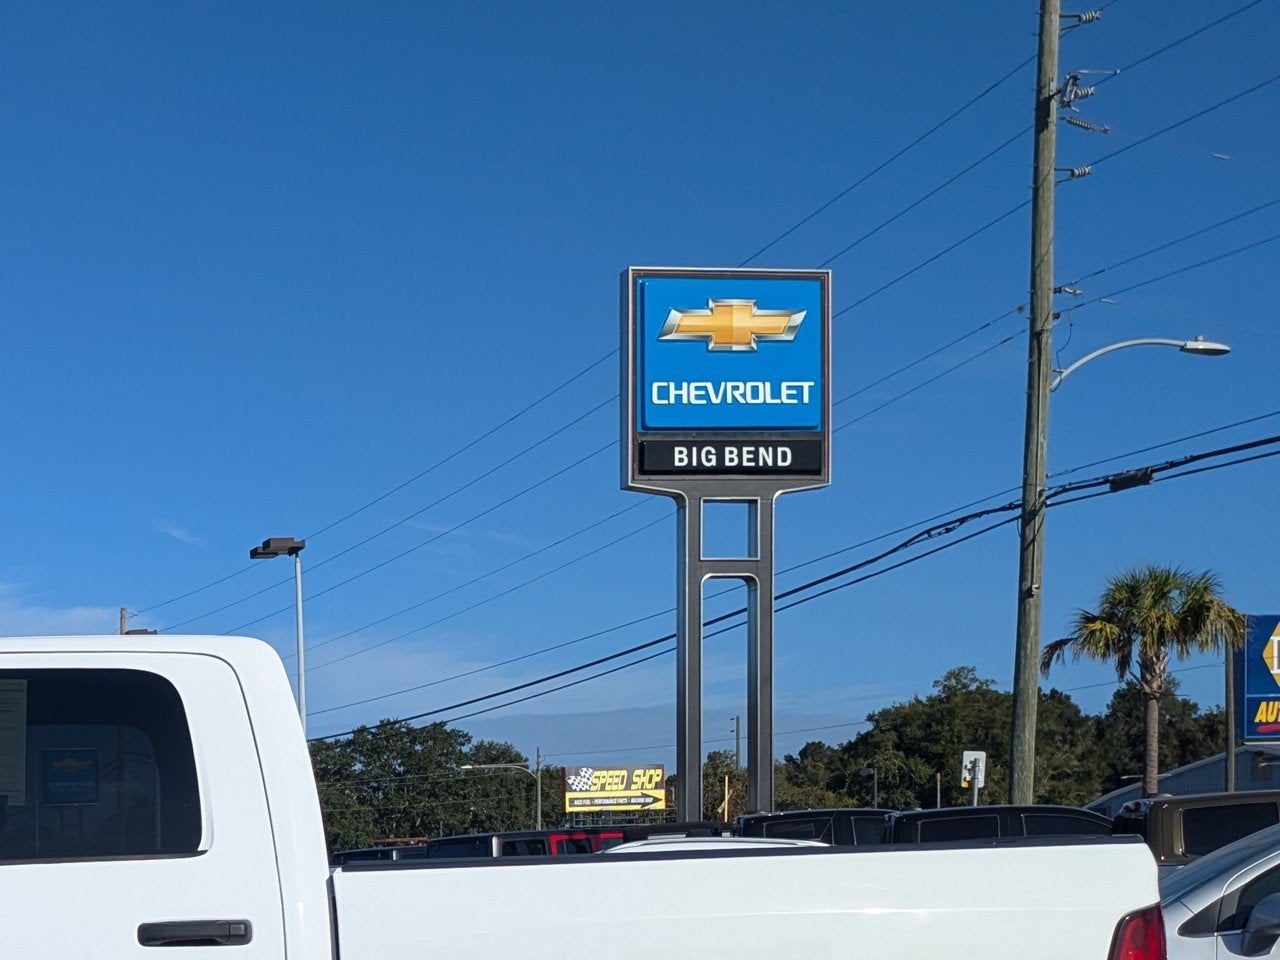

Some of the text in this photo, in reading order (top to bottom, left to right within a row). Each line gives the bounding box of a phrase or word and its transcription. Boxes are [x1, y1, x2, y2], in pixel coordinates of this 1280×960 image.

[651, 381, 815, 405] CHEVROLET
[674, 446, 793, 467] BIG BEND
[590, 768, 663, 791] SPEED SHOP
